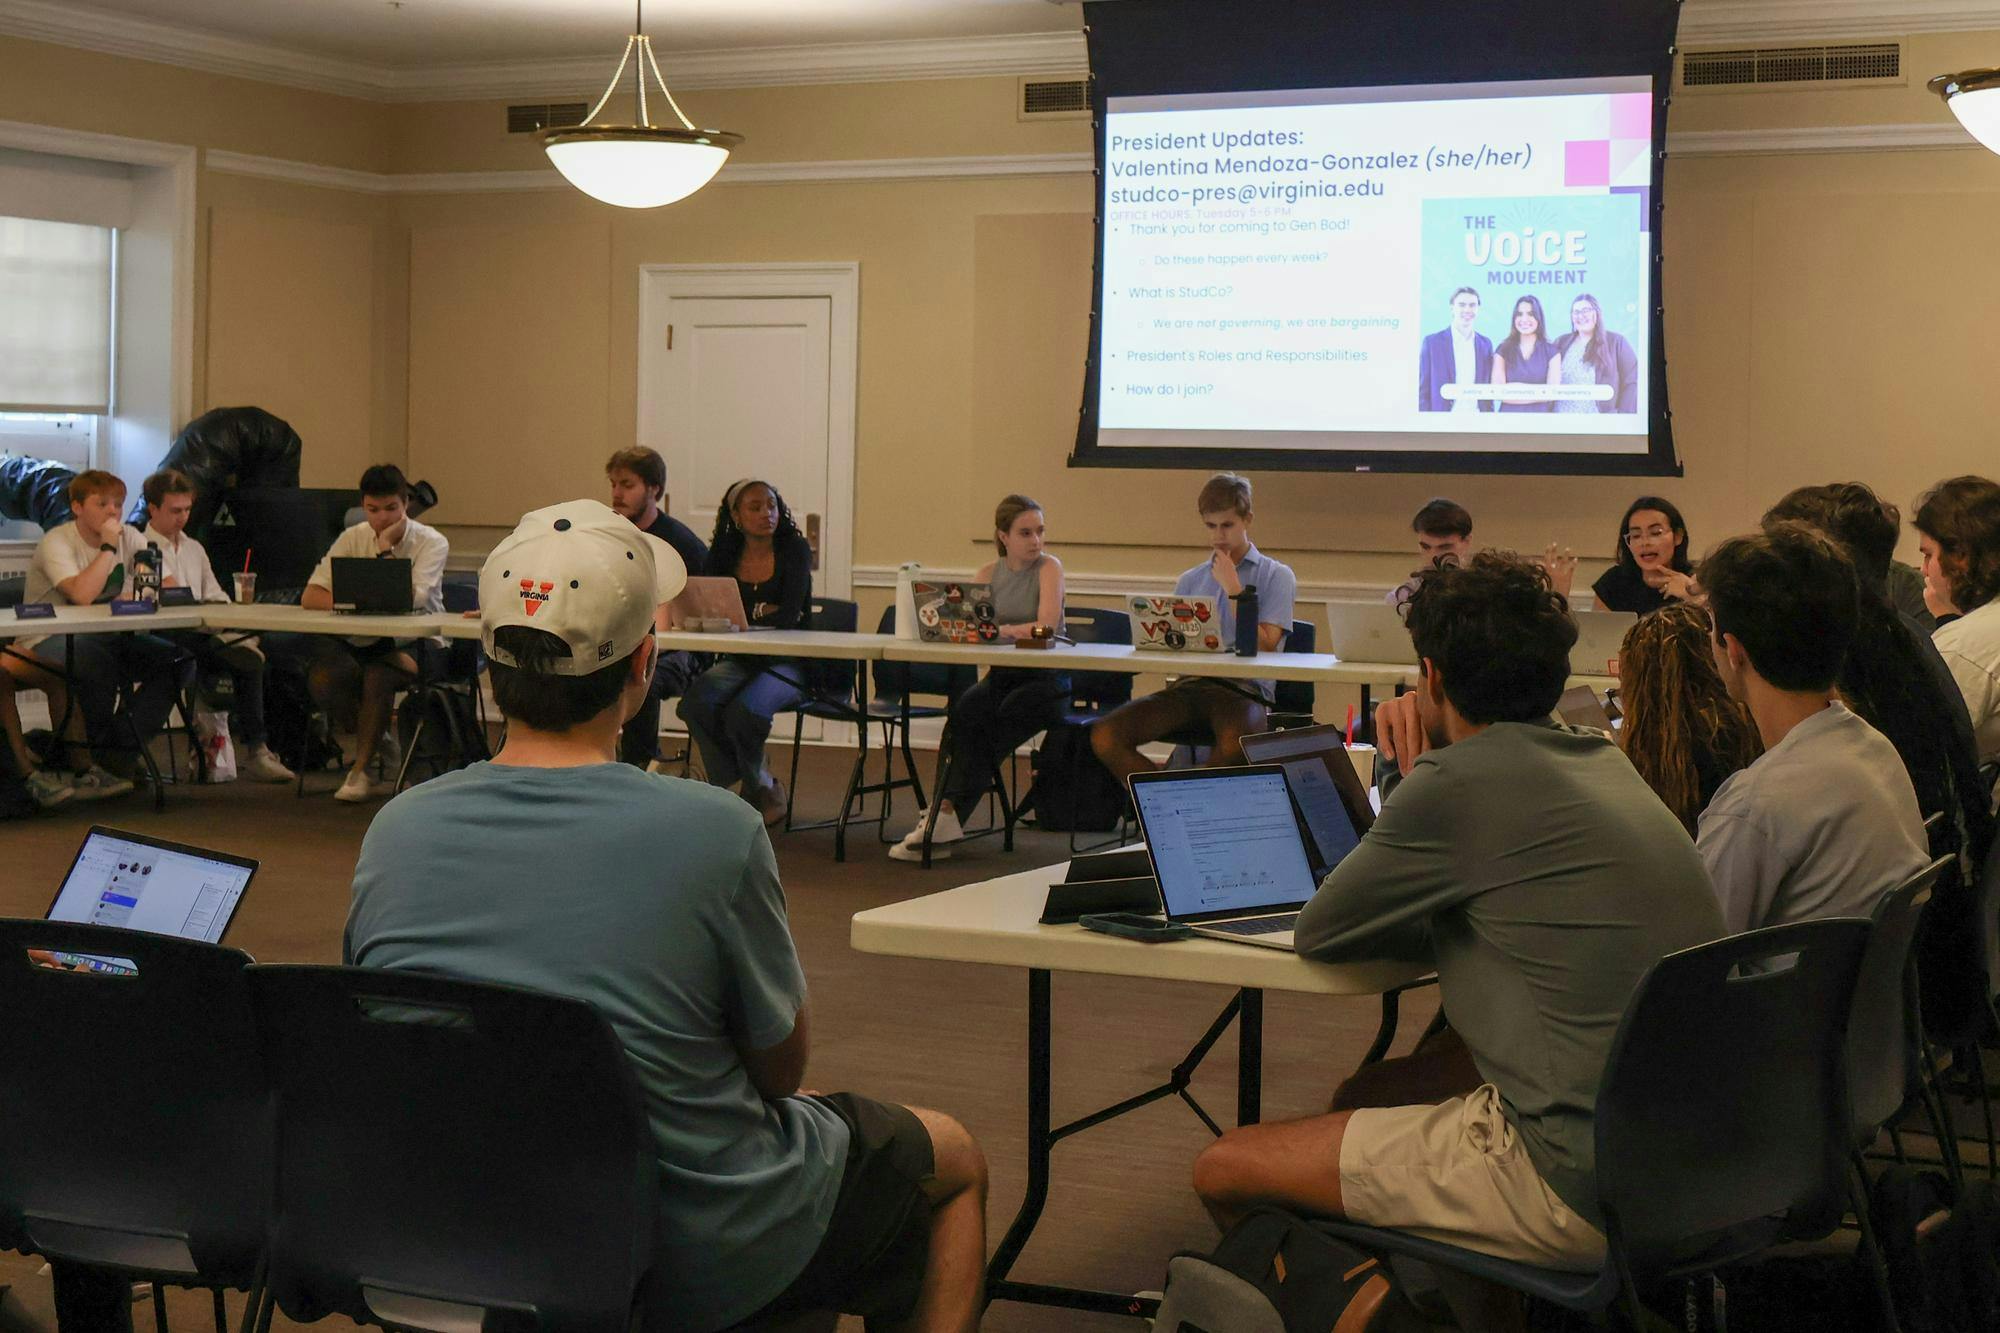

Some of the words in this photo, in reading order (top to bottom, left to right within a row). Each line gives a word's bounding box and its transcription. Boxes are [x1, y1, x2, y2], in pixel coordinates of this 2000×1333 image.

[1112, 133, 1206, 151] President
[1212, 130, 1304, 152] Updates:
[1112, 158, 1208, 177] Valentina
[1215, 152, 1419, 174] Mendoza-Gonzalez
[1426, 143, 1532, 172] (she/her)
[1111, 179, 1385, 206] studco-pres@virginia.edu
[1110, 209, 1148, 221] OFFICE
[1197, 207, 1246, 219] Tuesday
[1275, 205, 1292, 216] PM
[1130, 222, 1168, 235] Thank
[1171, 225, 1195, 236] you
[1199, 221, 1215, 233] for
[1219, 221, 1269, 236] coming
[1273, 220, 1285, 232] to
[1289, 219, 1316, 232] Gen
[1320, 217, 1350, 231] Bod!
[1464, 215, 1496, 229] THE
[1154, 255, 1169, 265] Do
[1173, 254, 1204, 265] these
[1208, 253, 1253, 267] happen
[1256, 253, 1288, 266] every
[1292, 251, 1328, 263] week?
[1488, 270, 1588, 285] MOVEMENT
[1129, 286, 1162, 298] What
[1166, 286, 1175, 298] is
[1179, 285, 1233, 298] StudCo?
[1153, 317, 1173, 329] We
[1175, 320, 1193, 329] are
[1197, 317, 1215, 329] not
[1287, 319, 1304, 328] we
[1310, 317, 1327, 328] are
[1330, 315, 1400, 330] bargaining
[1127, 350, 1196, 362] President's
[1199, 350, 1232, 362] Roles
[1236, 350, 1262, 362] and
[1266, 349, 1368, 364] Responsibilities
[1126, 384, 1153, 396] How
[1157, 383, 1174, 396] do
[1183, 382, 1214, 398] join?
[520, 591, 549, 601] VIRGINIA
